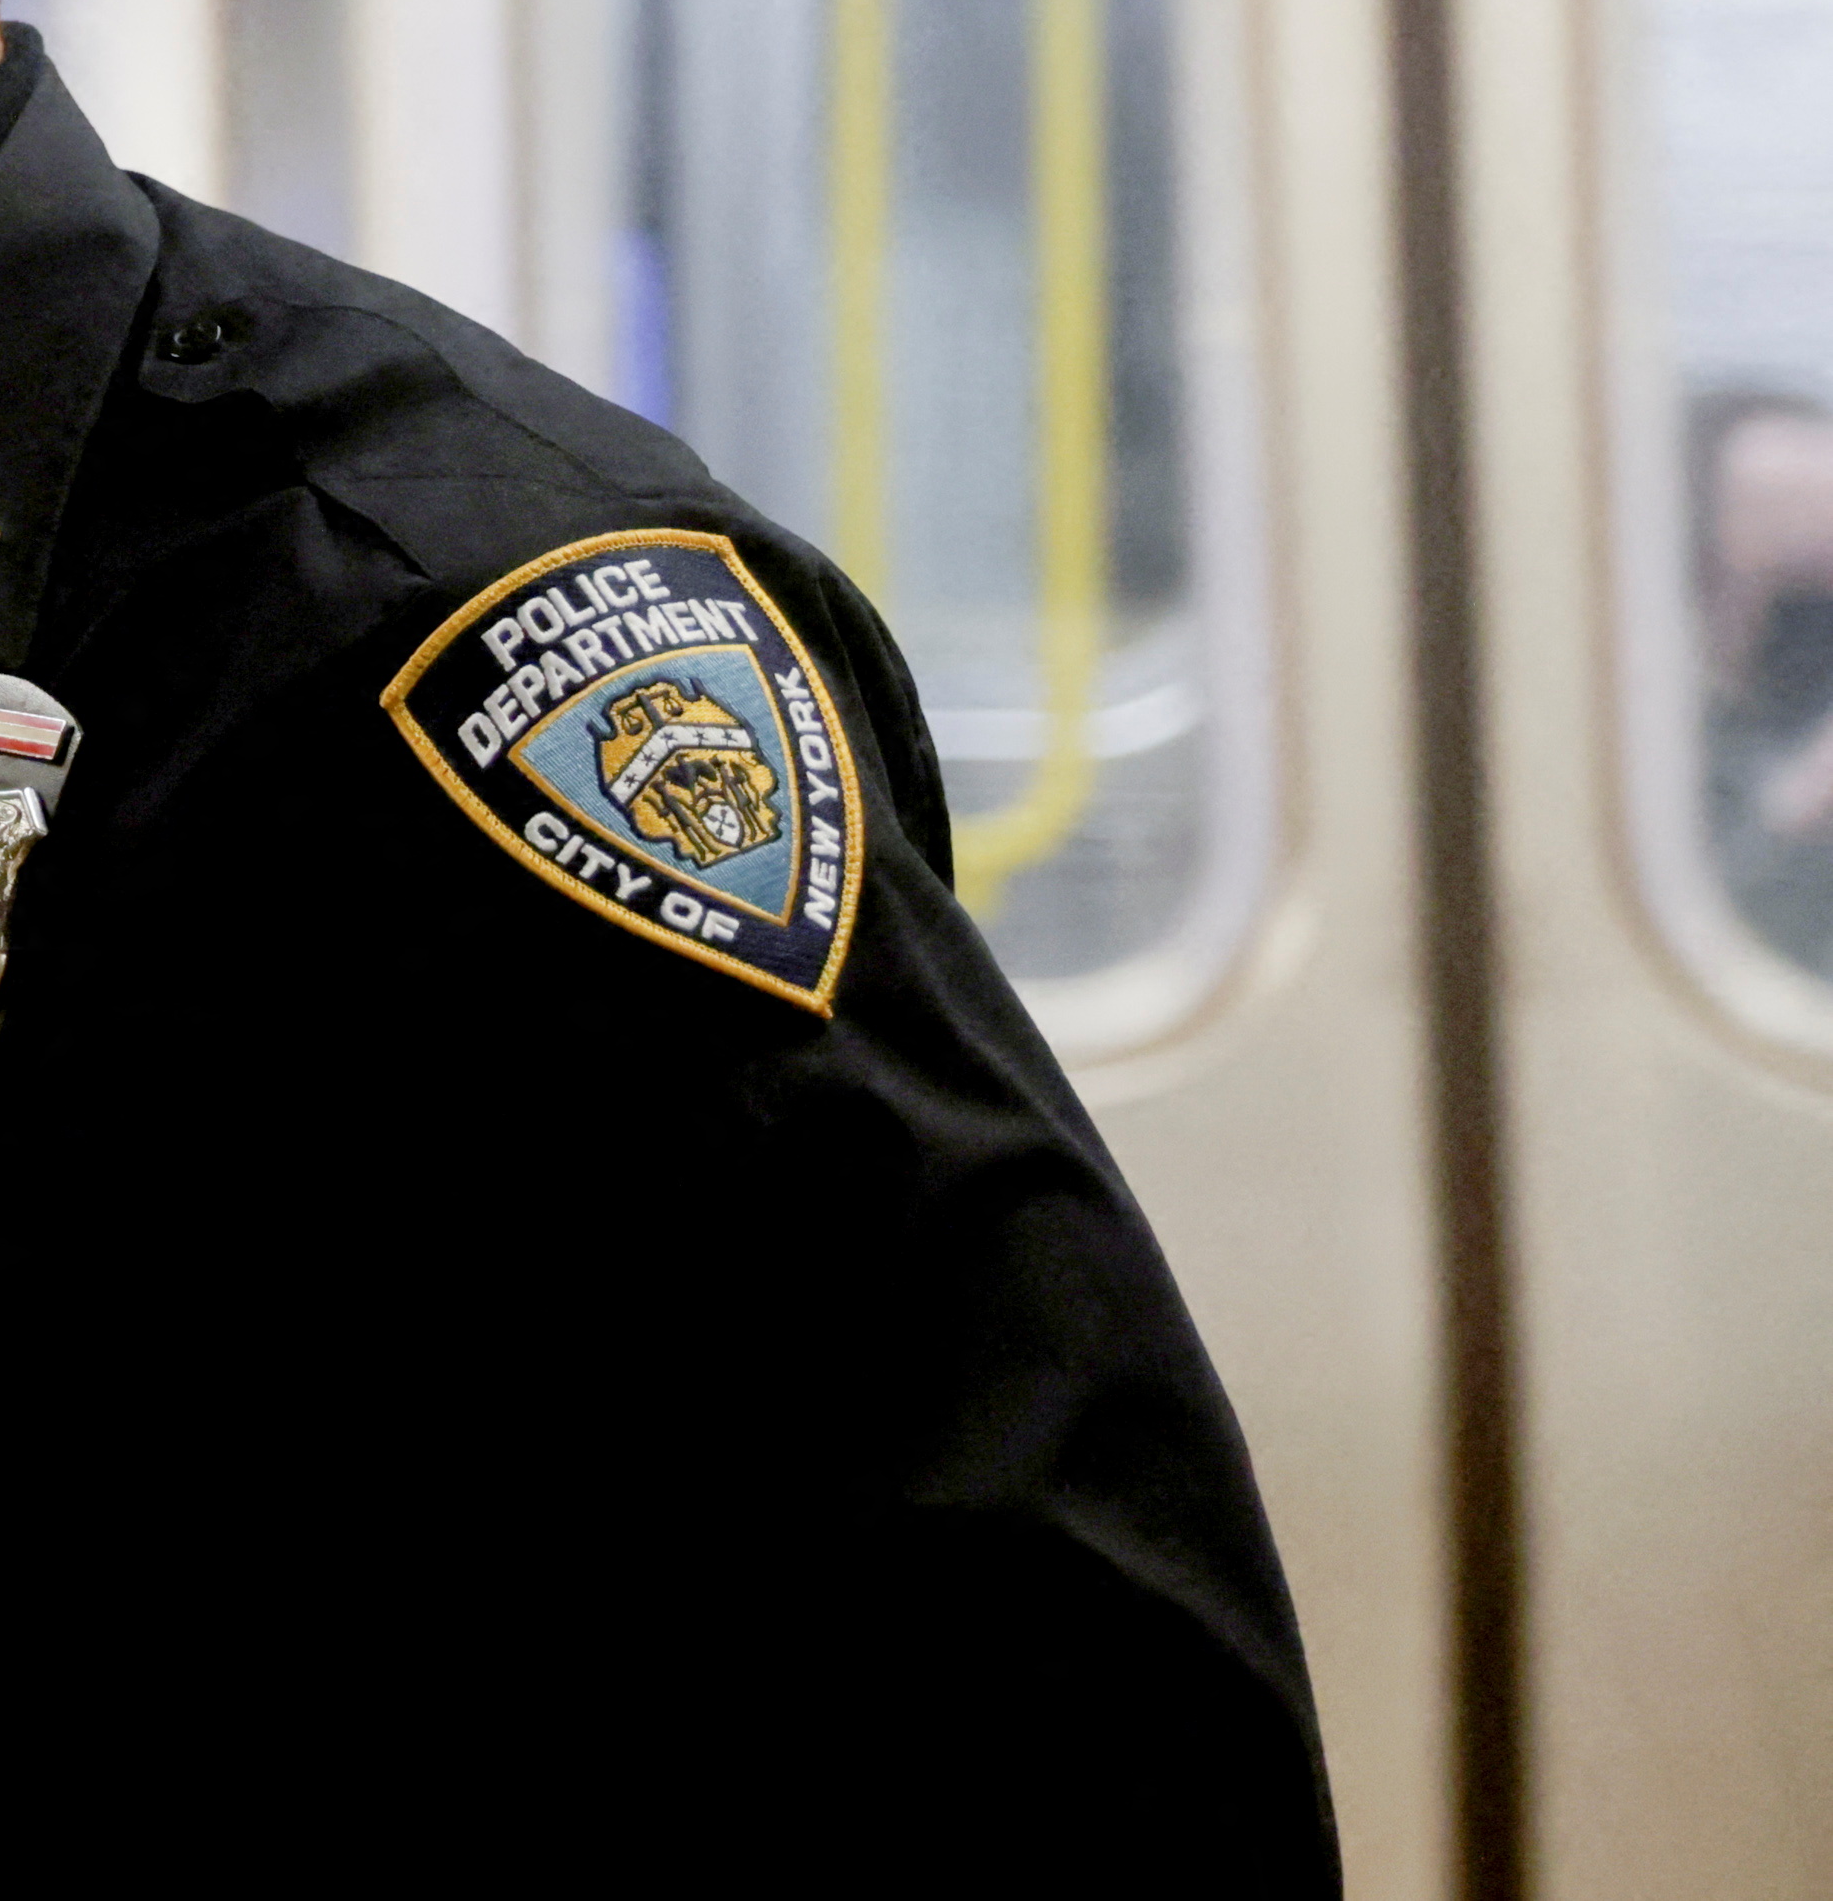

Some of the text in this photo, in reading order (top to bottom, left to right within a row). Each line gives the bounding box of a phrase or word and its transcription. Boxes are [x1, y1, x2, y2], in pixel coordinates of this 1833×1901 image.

[457, 598, 759, 770] DEPARTMENT
[480, 559, 671, 672] POLICE
[773, 666, 842, 931] NEW YORK
[523, 810, 741, 942] CITY OF
